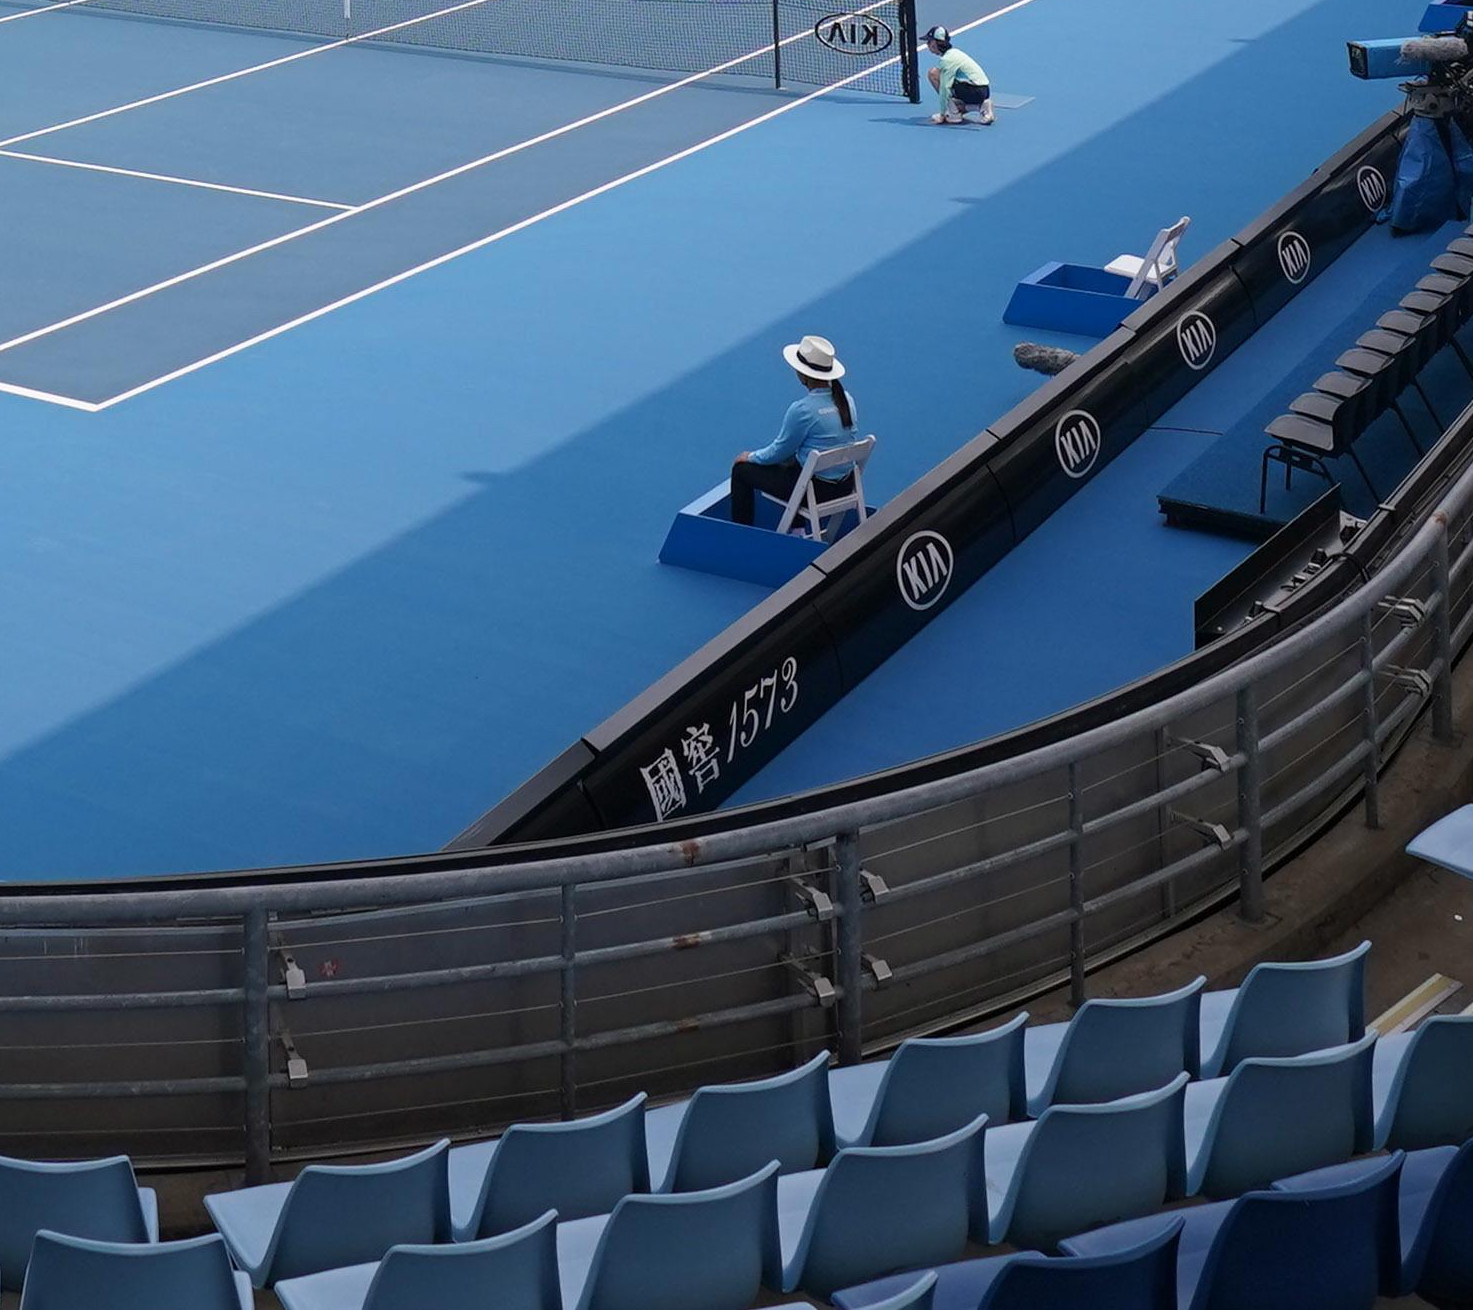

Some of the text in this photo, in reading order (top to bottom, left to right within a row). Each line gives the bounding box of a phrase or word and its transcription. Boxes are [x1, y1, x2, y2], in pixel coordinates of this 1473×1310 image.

[1282, 239, 1308, 276] KIA
[1181, 319, 1213, 361] KIA
[1060, 420, 1097, 468] KIA
[902, 542, 948, 599] KIA
[727, 656, 798, 764] 1573
